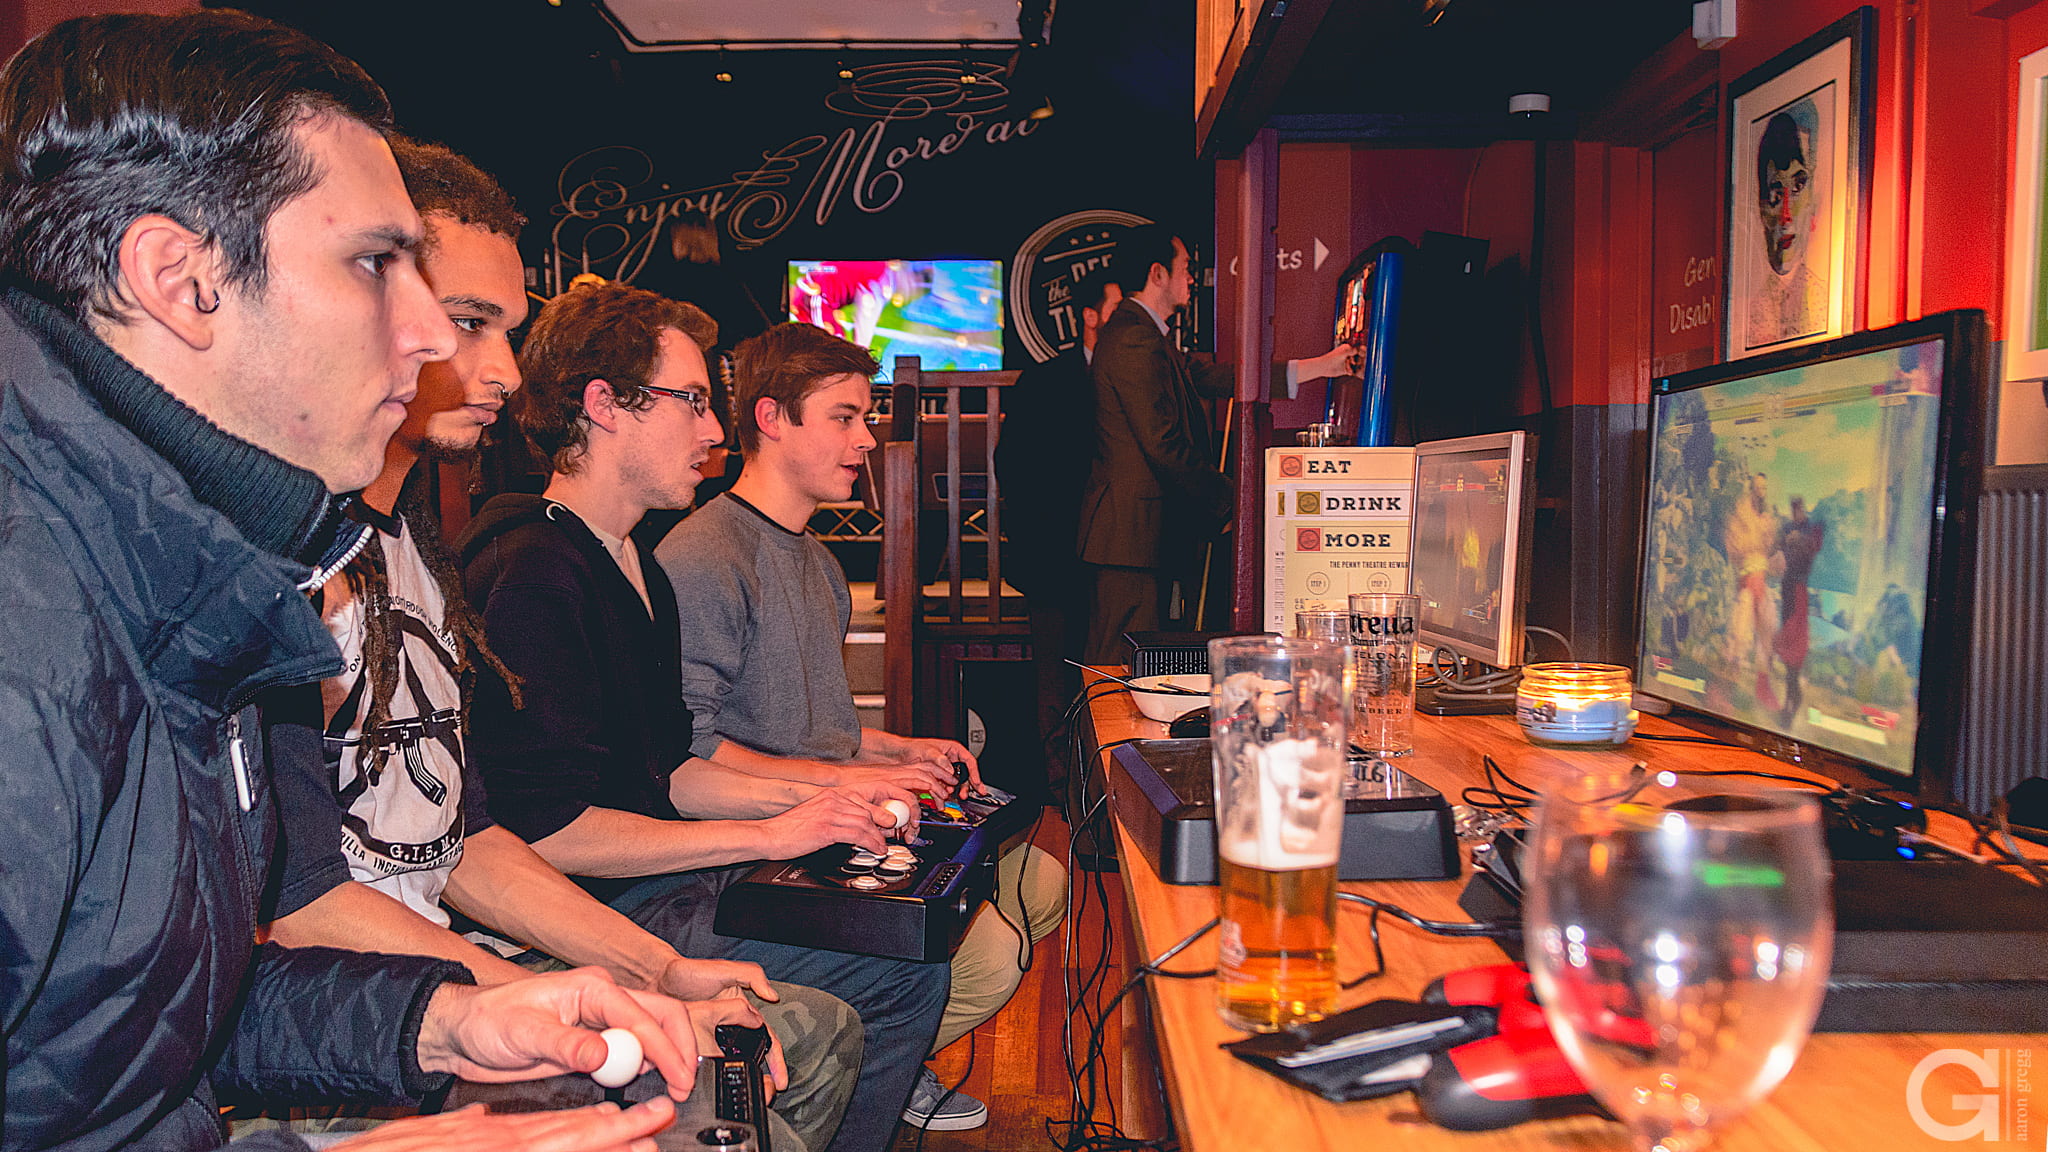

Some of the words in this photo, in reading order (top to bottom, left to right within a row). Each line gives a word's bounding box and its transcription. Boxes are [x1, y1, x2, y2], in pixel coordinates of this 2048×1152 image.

[1683, 255, 1716, 287] Gen
[1669, 295, 1716, 334] Disabl
[1307, 460, 1351, 474] EAT
[1325, 497, 1401, 511] DRINK
[1325, 534, 1391, 548] MORE
[1329, 561, 1341, 569] THE
[1342, 561, 1361, 569] PENNY
[1362, 561, 1387, 569] THEATRE
[1388, 561, 1409, 569] REWAR
